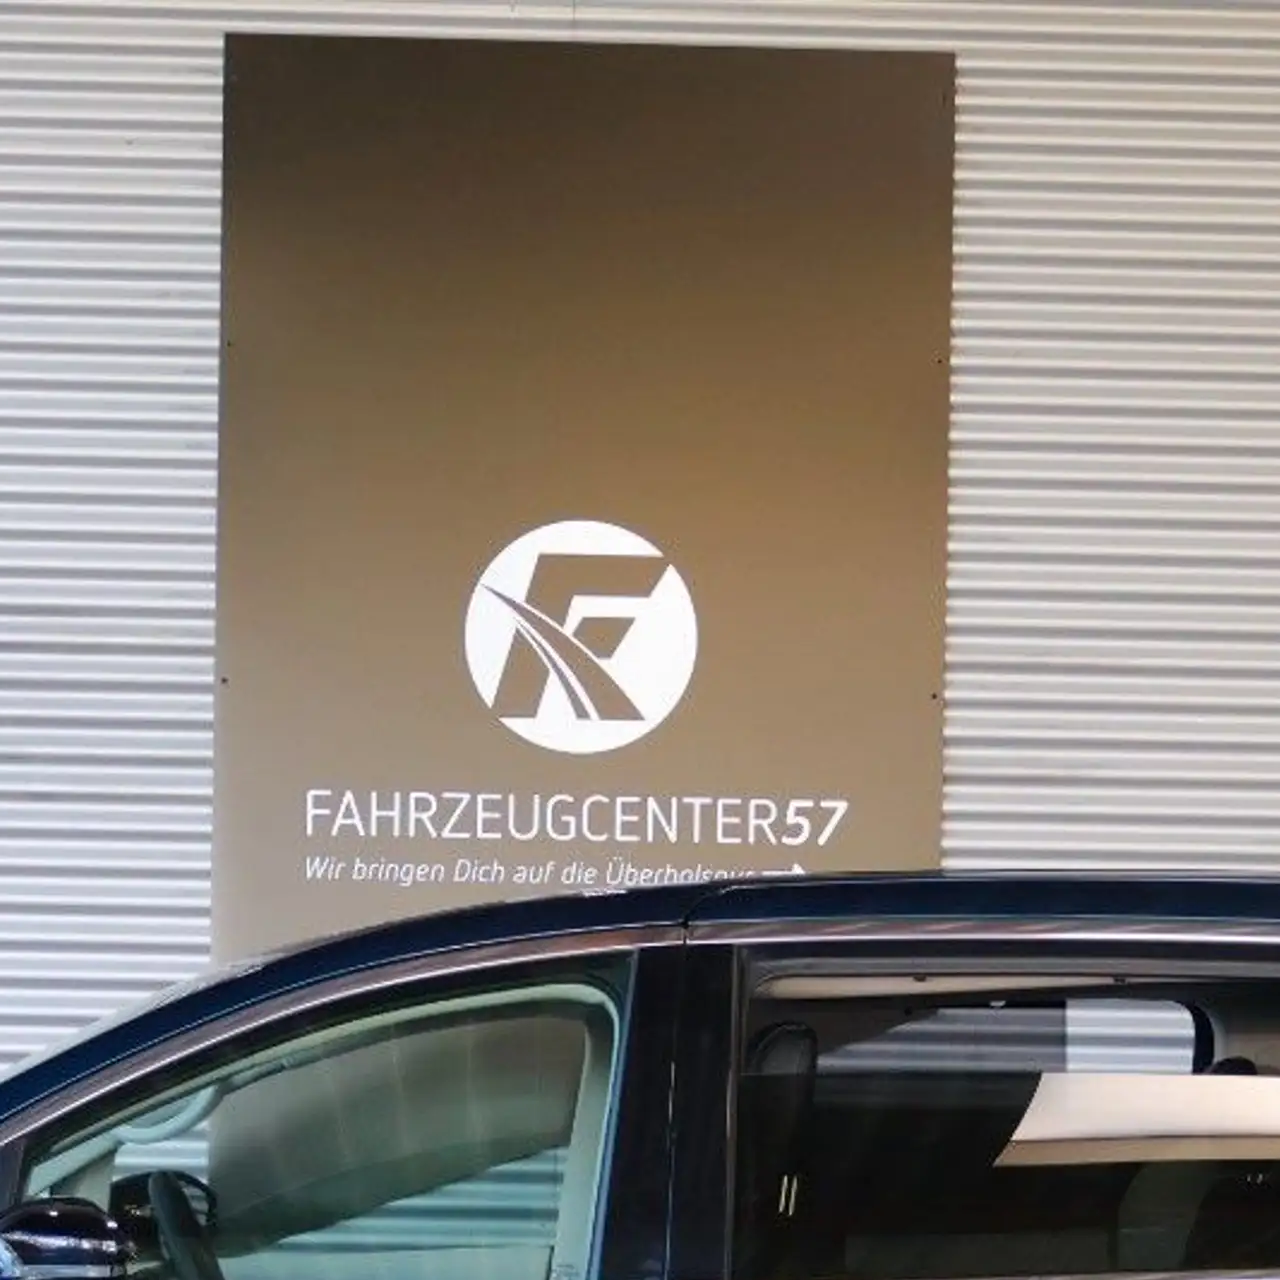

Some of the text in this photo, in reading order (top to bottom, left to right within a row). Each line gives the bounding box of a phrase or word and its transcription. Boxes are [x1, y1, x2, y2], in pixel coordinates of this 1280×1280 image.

[305, 789, 849, 845] FAHRZEUGCENTER57
[304, 856, 346, 881] Wir
[352, 857, 445, 887] bringen
[453, 858, 506, 883] Dich
[512, 861, 555, 884] auf
[560, 862, 597, 885] die
